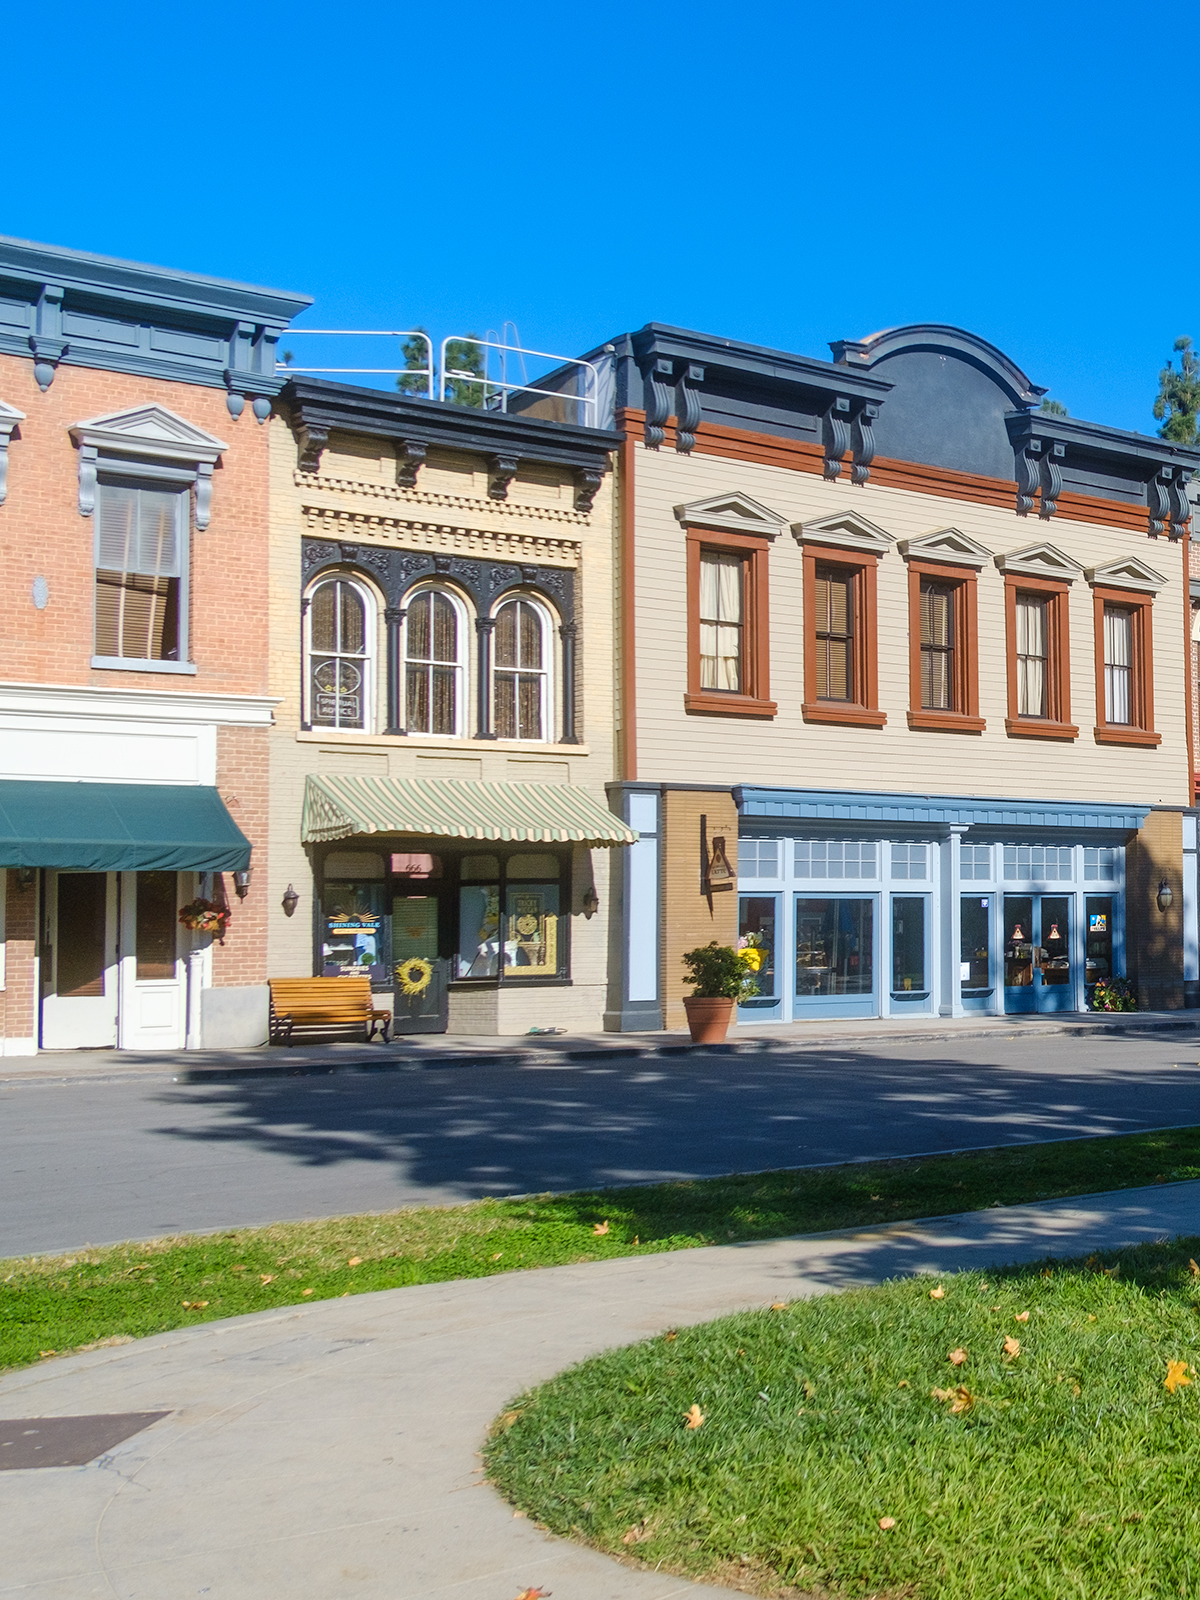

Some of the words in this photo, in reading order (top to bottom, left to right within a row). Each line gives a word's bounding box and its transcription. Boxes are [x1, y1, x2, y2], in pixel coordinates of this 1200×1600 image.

[321, 698, 356, 707] SPIRTUAL
[322, 707, 353, 715] ADICE
[405, 863, 422, 873] 666
